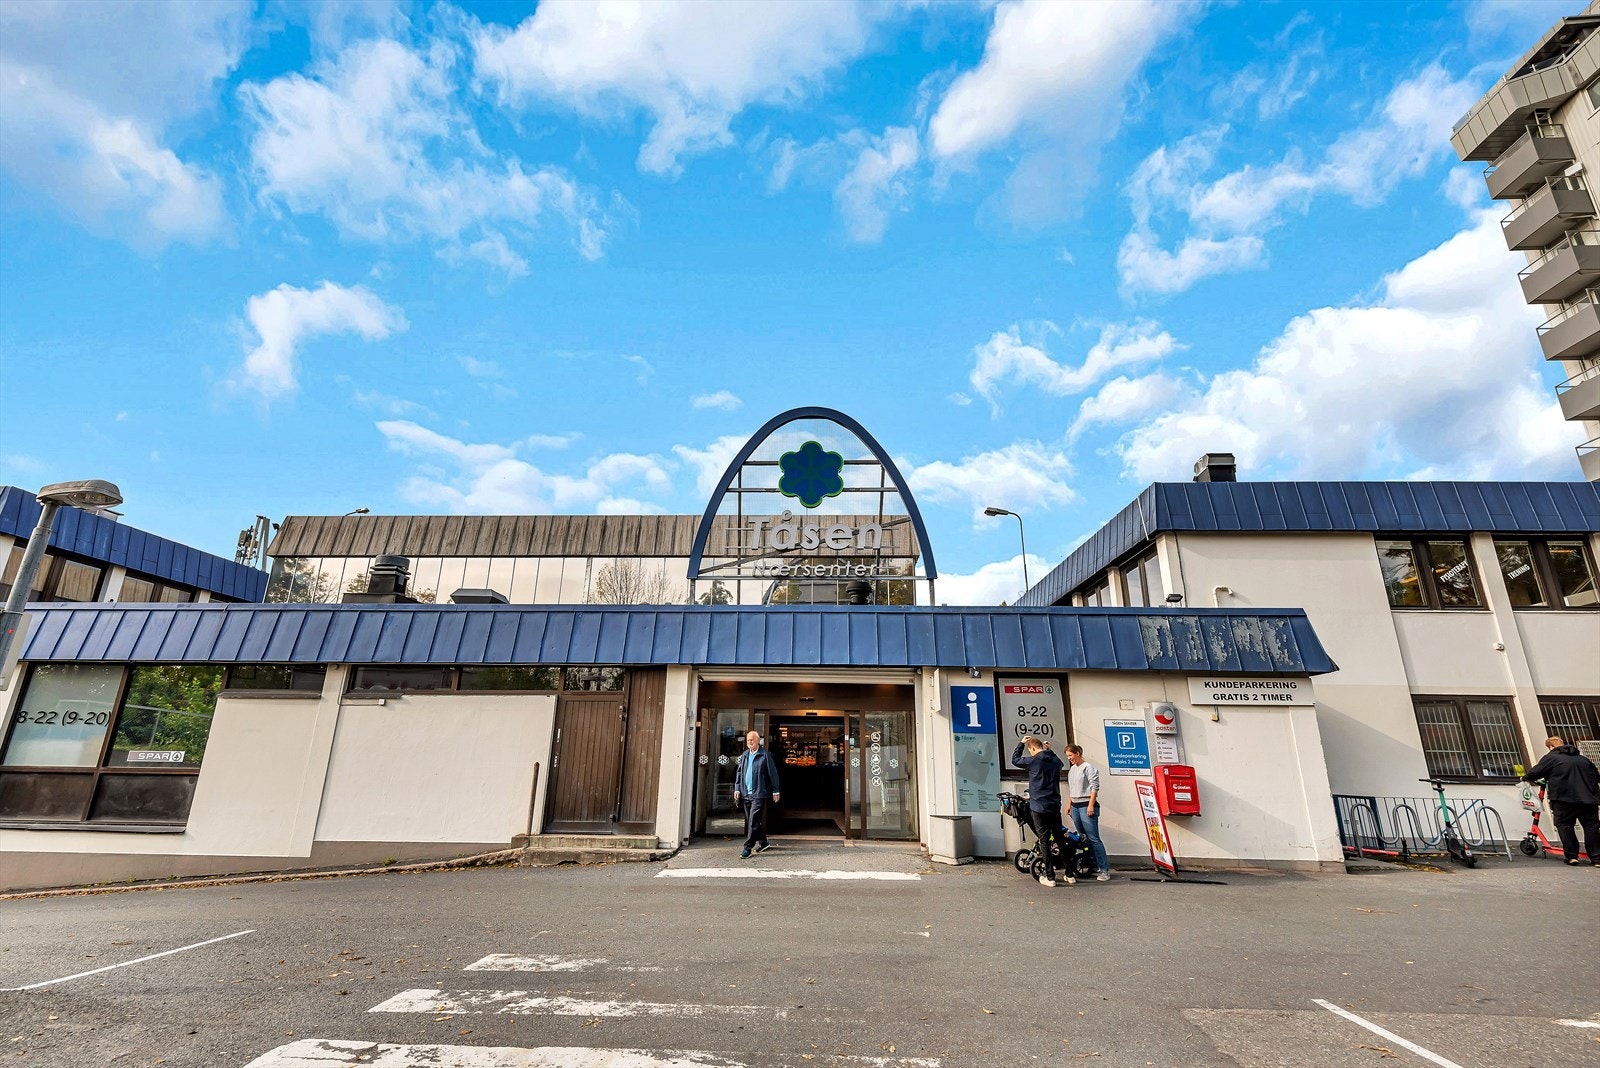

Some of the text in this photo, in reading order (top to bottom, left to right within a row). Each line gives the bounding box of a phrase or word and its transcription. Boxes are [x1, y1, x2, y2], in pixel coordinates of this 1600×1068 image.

[749, 510, 883, 550] Tåsen
[752, 560, 879, 577] Nærsenter
[1507, 564, 1530, 579] TRENING
[1204, 681, 1297, 689] KUNDEPARKERING
[1212, 693, 1250, 701] GRATIS
[1252, 693, 1259, 701] 2
[1018, 706, 1047, 717] 8-22
[16, 710, 112, 727] 8-22 (9-20)
[1015, 723, 1053, 737] (9-20)
[1121, 735, 1131, 746] P
[138, 752, 169, 760] SPAR
